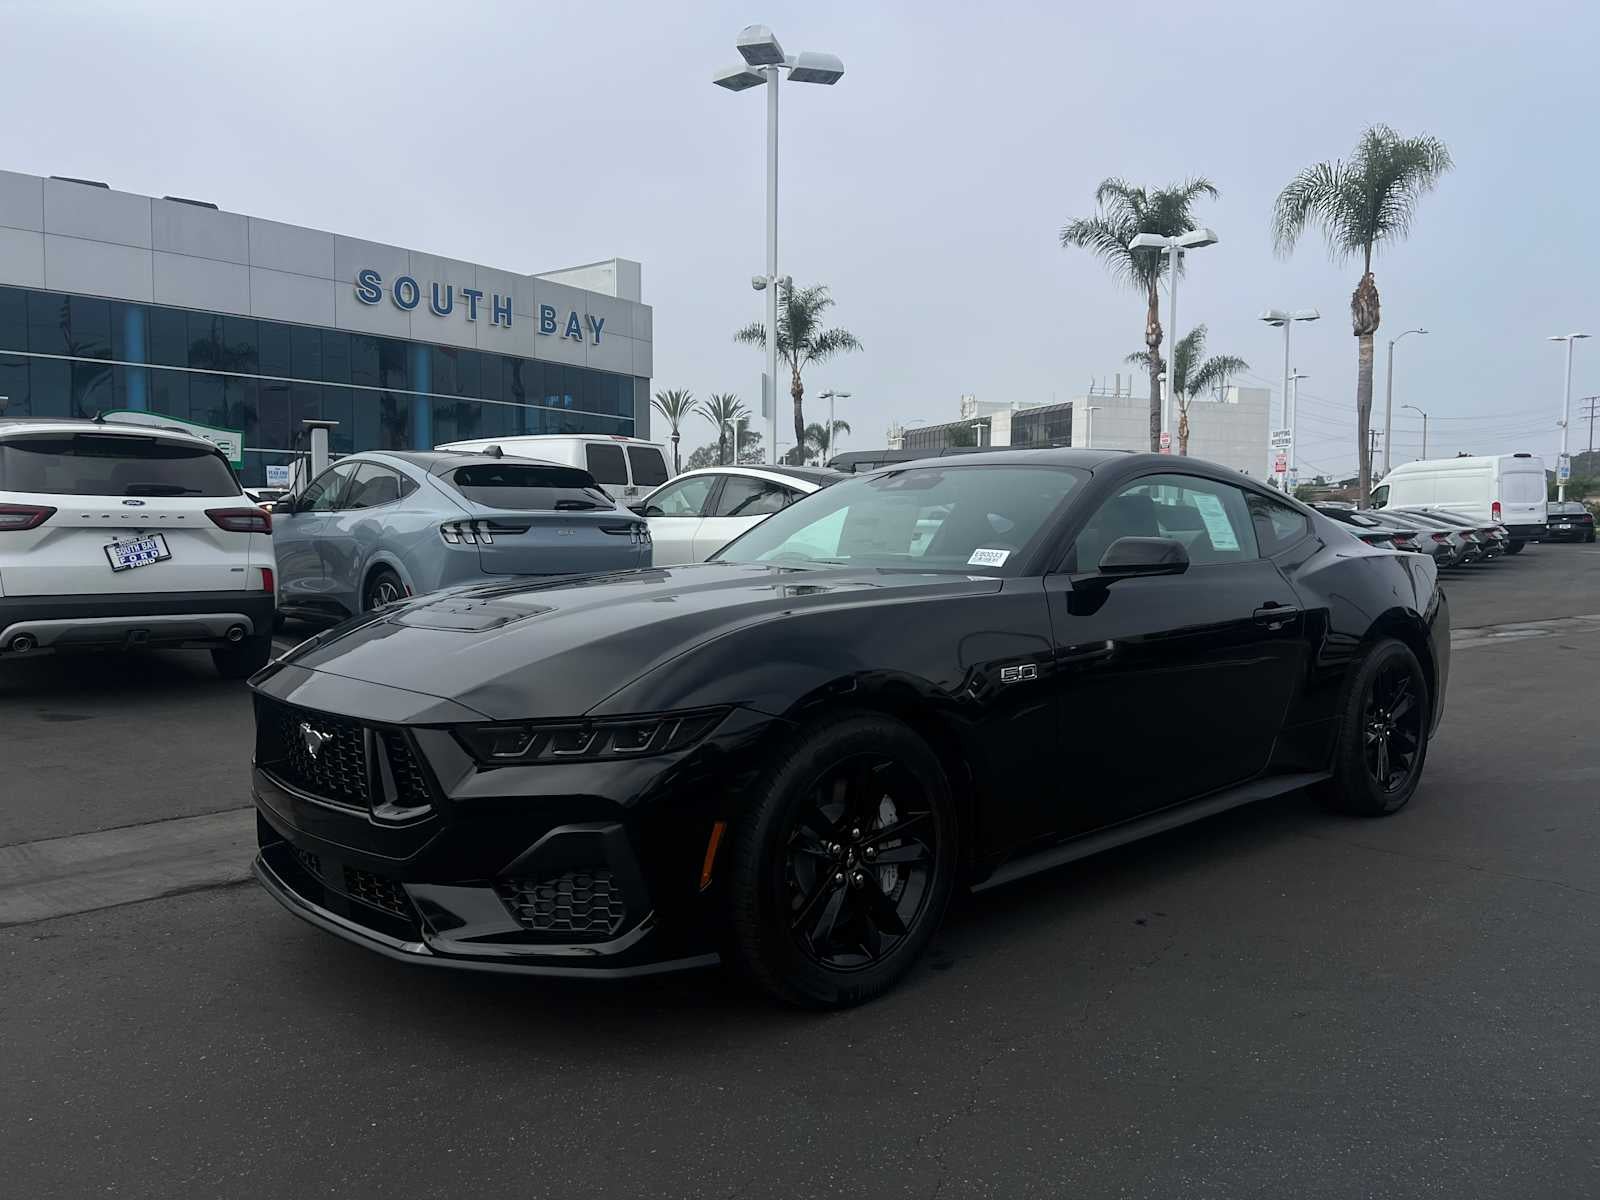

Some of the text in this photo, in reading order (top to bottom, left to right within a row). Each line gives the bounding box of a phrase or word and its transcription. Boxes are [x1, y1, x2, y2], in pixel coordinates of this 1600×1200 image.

[356, 269, 605, 345] SOUTH BAY
[116, 543, 140, 555] SOUTH
[142, 540, 156, 550] BAY
[120, 550, 158, 564] FORD
[130, 558, 156, 568] FORD
